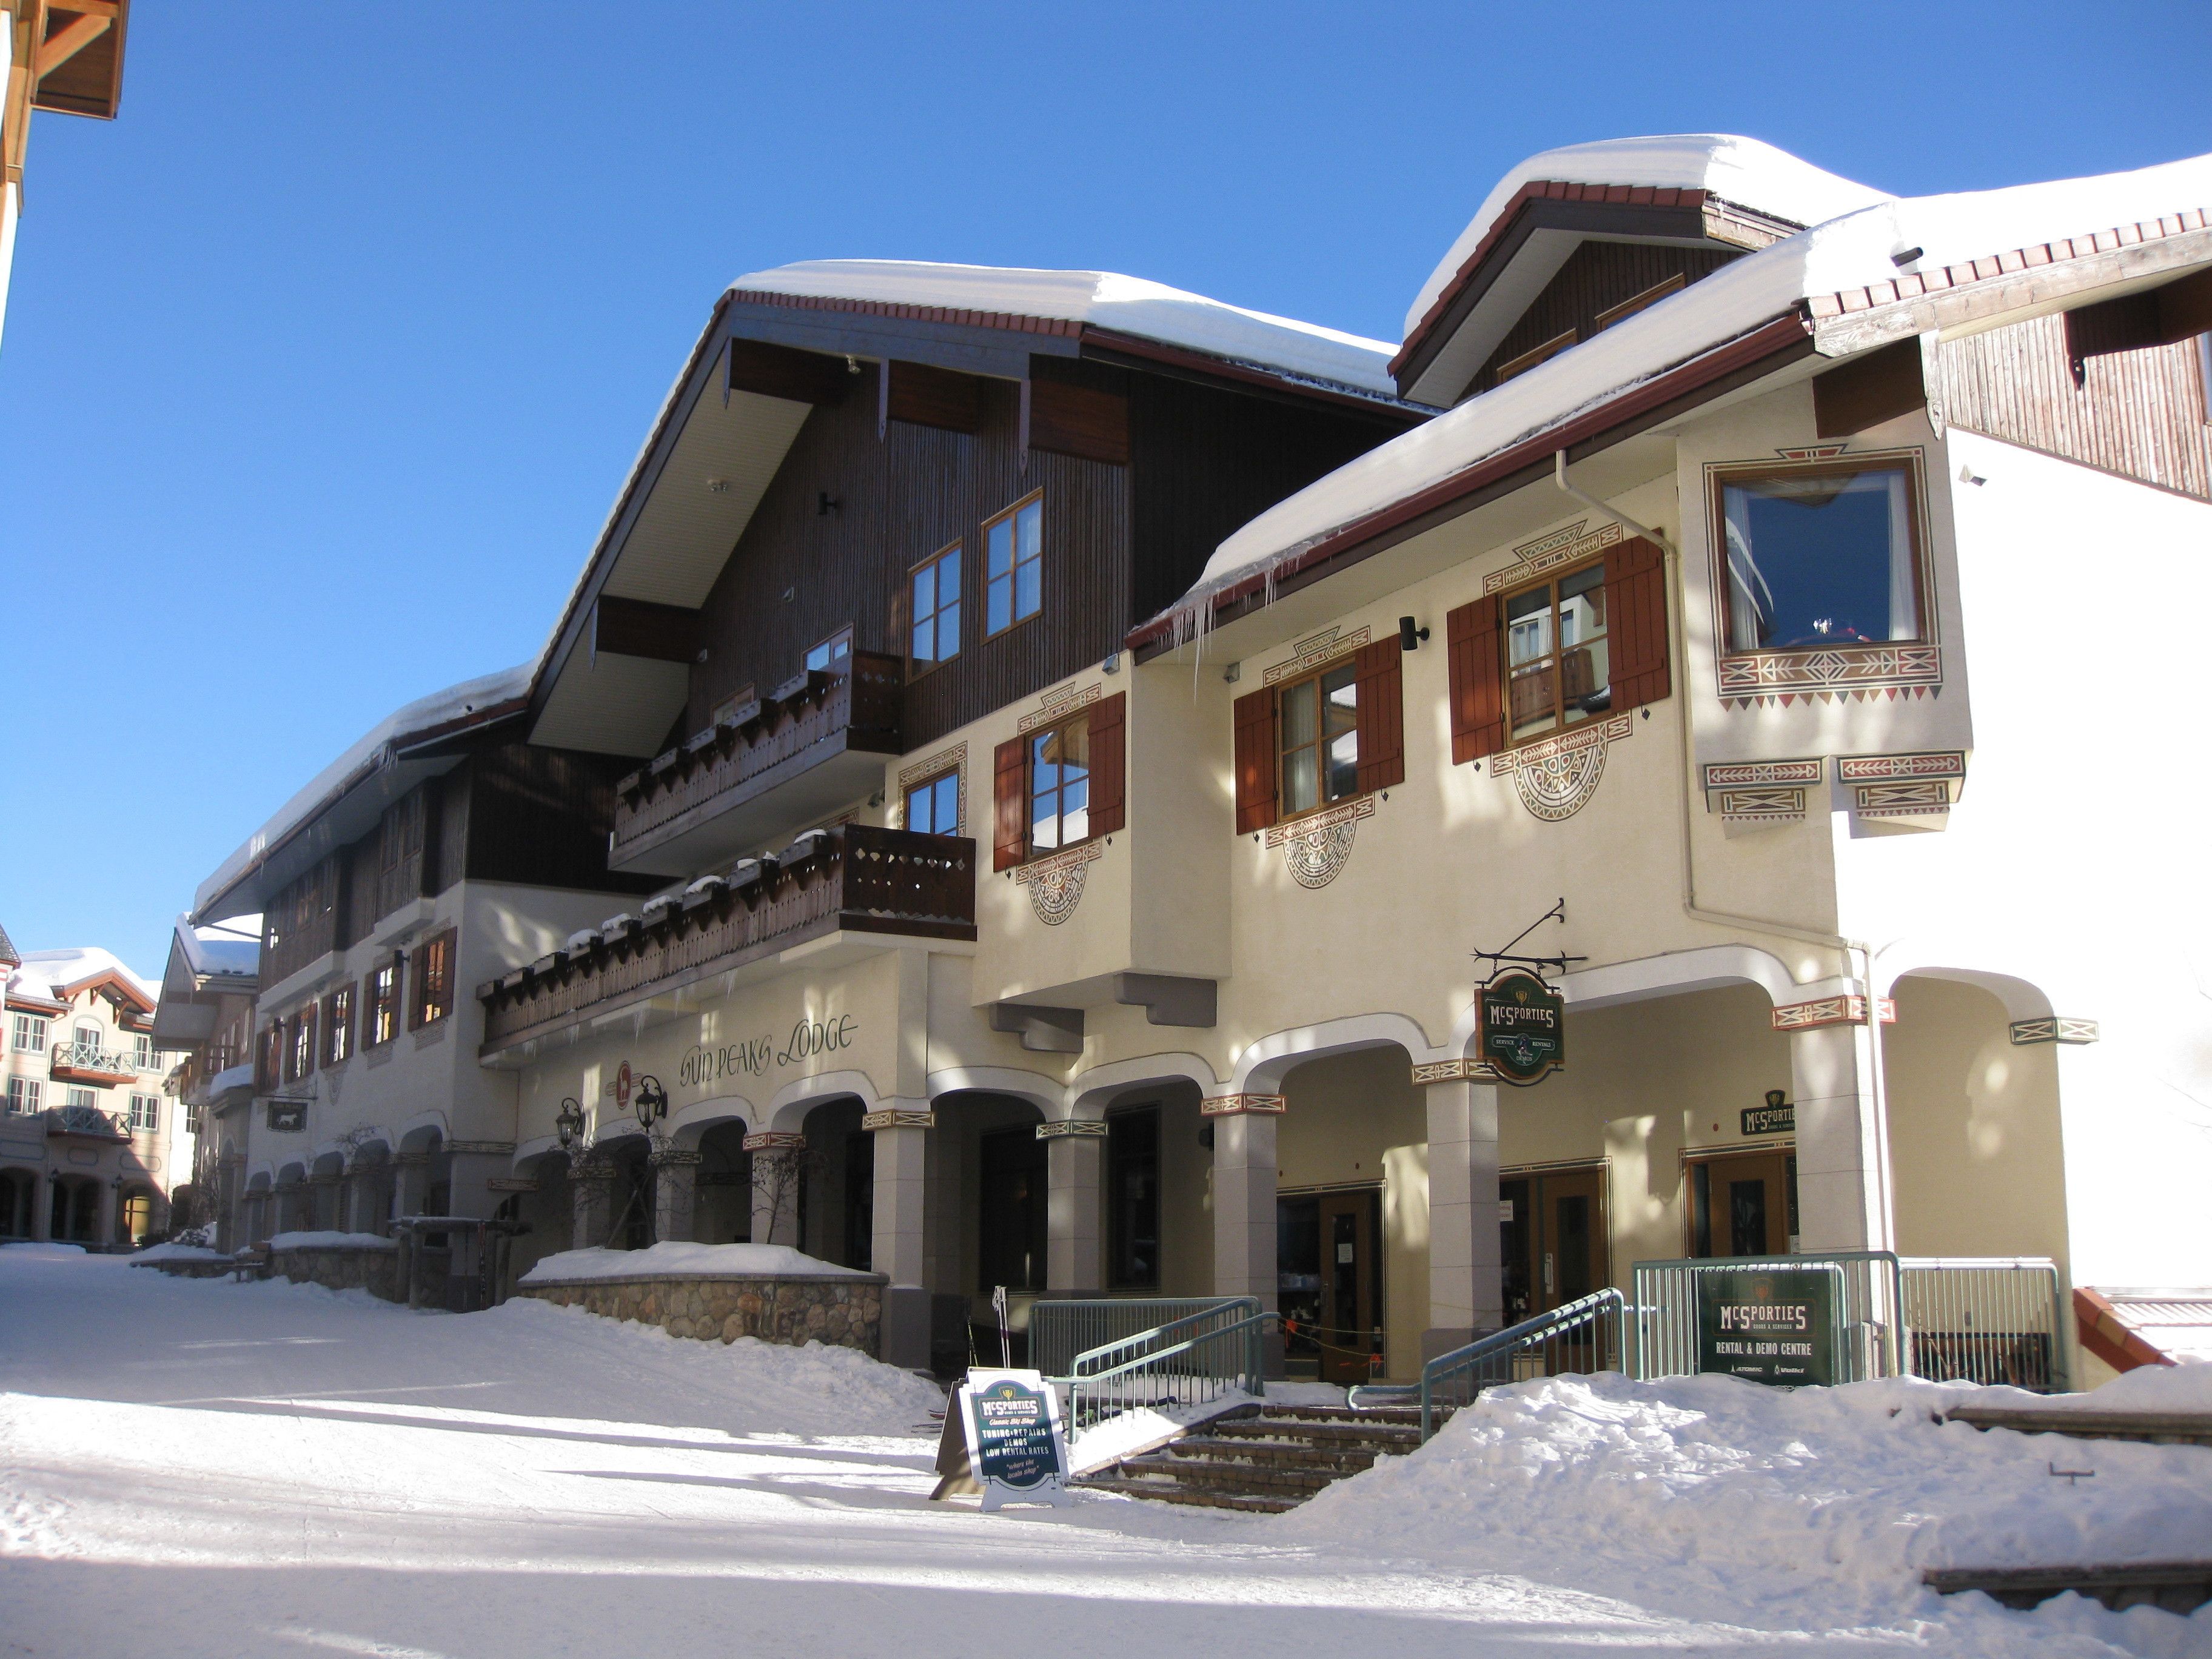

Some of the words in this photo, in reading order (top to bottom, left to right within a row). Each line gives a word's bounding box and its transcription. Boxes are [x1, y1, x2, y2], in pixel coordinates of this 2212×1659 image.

[716, 1034, 772, 1079] PEAKS
[777, 1014, 859, 1067] LODGE
[1746, 1108, 1794, 1131] McSPORTIE
[1716, 1341, 1744, 1354] RENTAL
[1746, 1342, 1753, 1355] &
[1756, 1342, 1778, 1355] DEMO
[1781, 1342, 1812, 1356] CENTRE
[1004, 1438, 1028, 1447] DEMOS
[985, 1448, 1000, 1457] LOW
[1002, 1447, 1028, 1456] RENTAL
[1028, 1446, 1050, 1455] RATES
